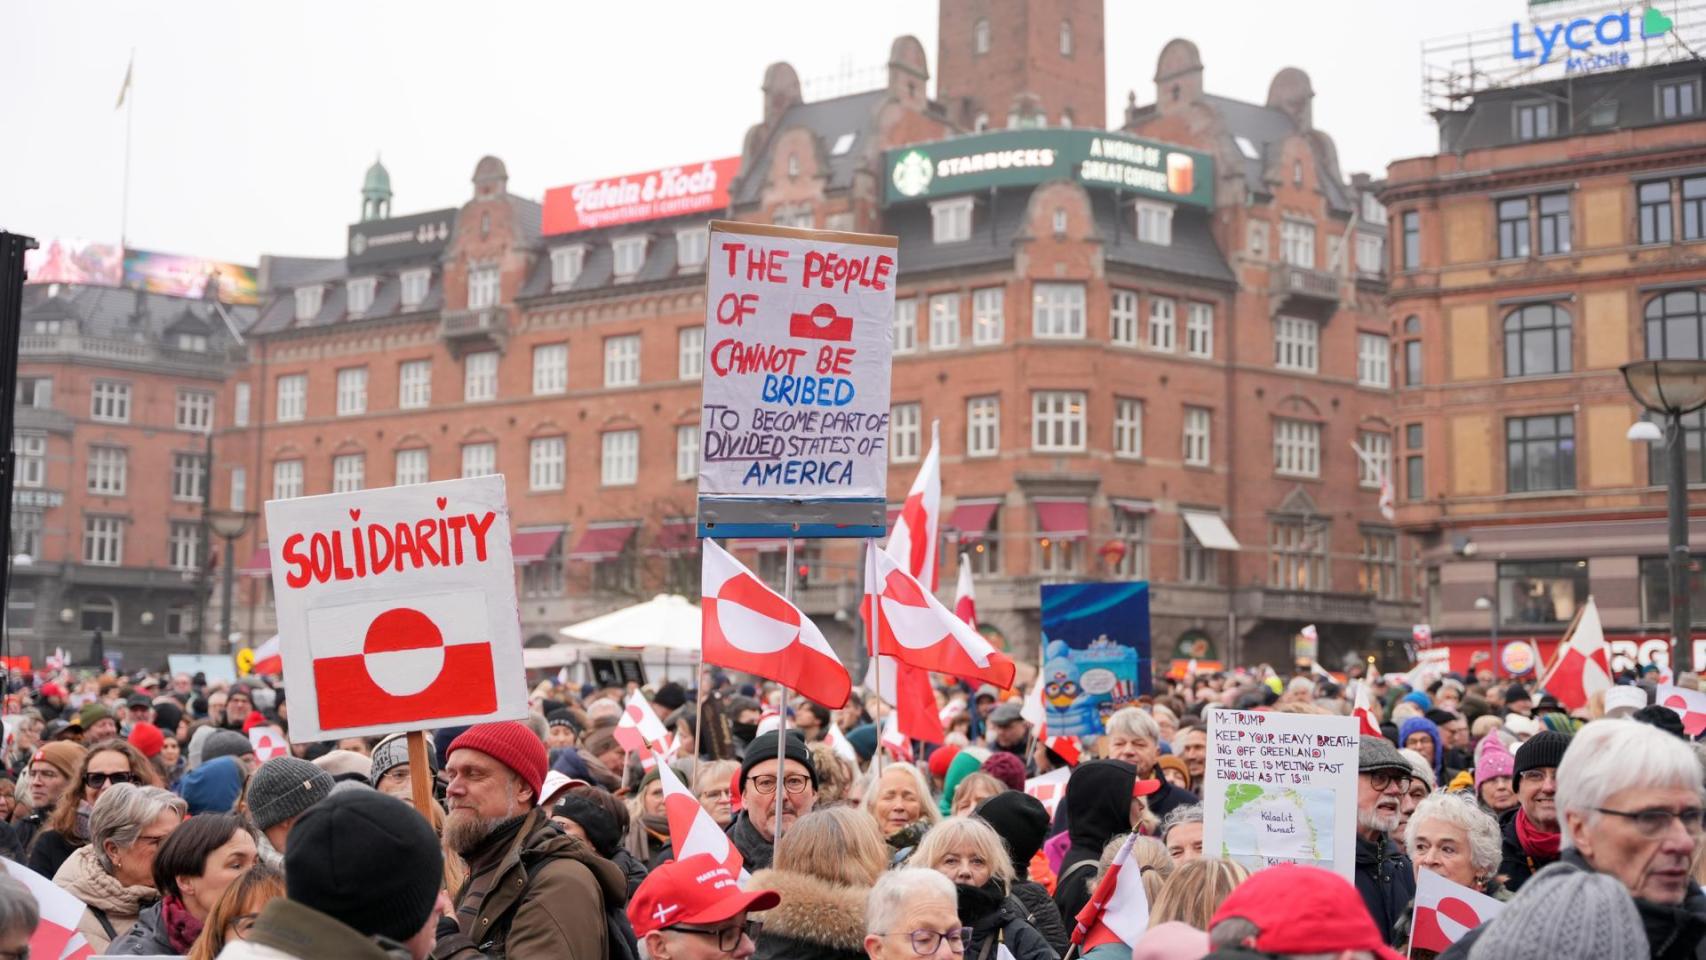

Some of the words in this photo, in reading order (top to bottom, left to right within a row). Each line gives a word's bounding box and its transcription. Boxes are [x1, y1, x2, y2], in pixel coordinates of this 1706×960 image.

[1512, 11, 1630, 65] Lyca
[937, 148, 1054, 177] STARBUCKS
[1090, 137, 1102, 157] A
[1102, 138, 1144, 164] WORLD
[1144, 146, 1160, 168] OF
[641, 175, 657, 202] &
[658, 161, 717, 198] Koch
[1081, 159, 1124, 183] GREAT
[721, 242, 790, 283] THE
[802, 250, 894, 294] PEOPLE
[716, 292, 759, 327] OF
[710, 338, 807, 377] CANNOT
[816, 345, 857, 375] BE
[761, 374, 855, 406] BRIBED
[704, 404, 740, 431] TO
[752, 408, 820, 433] BECOME
[820, 411, 866, 434] PART
[865, 413, 889, 433] OF
[787, 435, 855, 457] STATES
[857, 437, 885, 457] OF
[742, 460, 854, 486] AMERICA
[1231, 712, 1265, 726] TRUMP
[1215, 729, 1245, 741] KEEP
[1249, 732, 1275, 745] YOUR
[1279, 733, 1313, 745] HEAVY
[1236, 746, 1256, 756] OFF
[1216, 758, 1237, 768] THE
[1276, 760, 1315, 772] MELTING
[1318, 762, 1344, 774] FAST
[1217, 769, 1255, 782] ENOUGH
[1258, 772, 1273, 783] AS
[1261, 811, 1293, 822] Kalaalit
[1266, 823, 1296, 834] Nunaat
